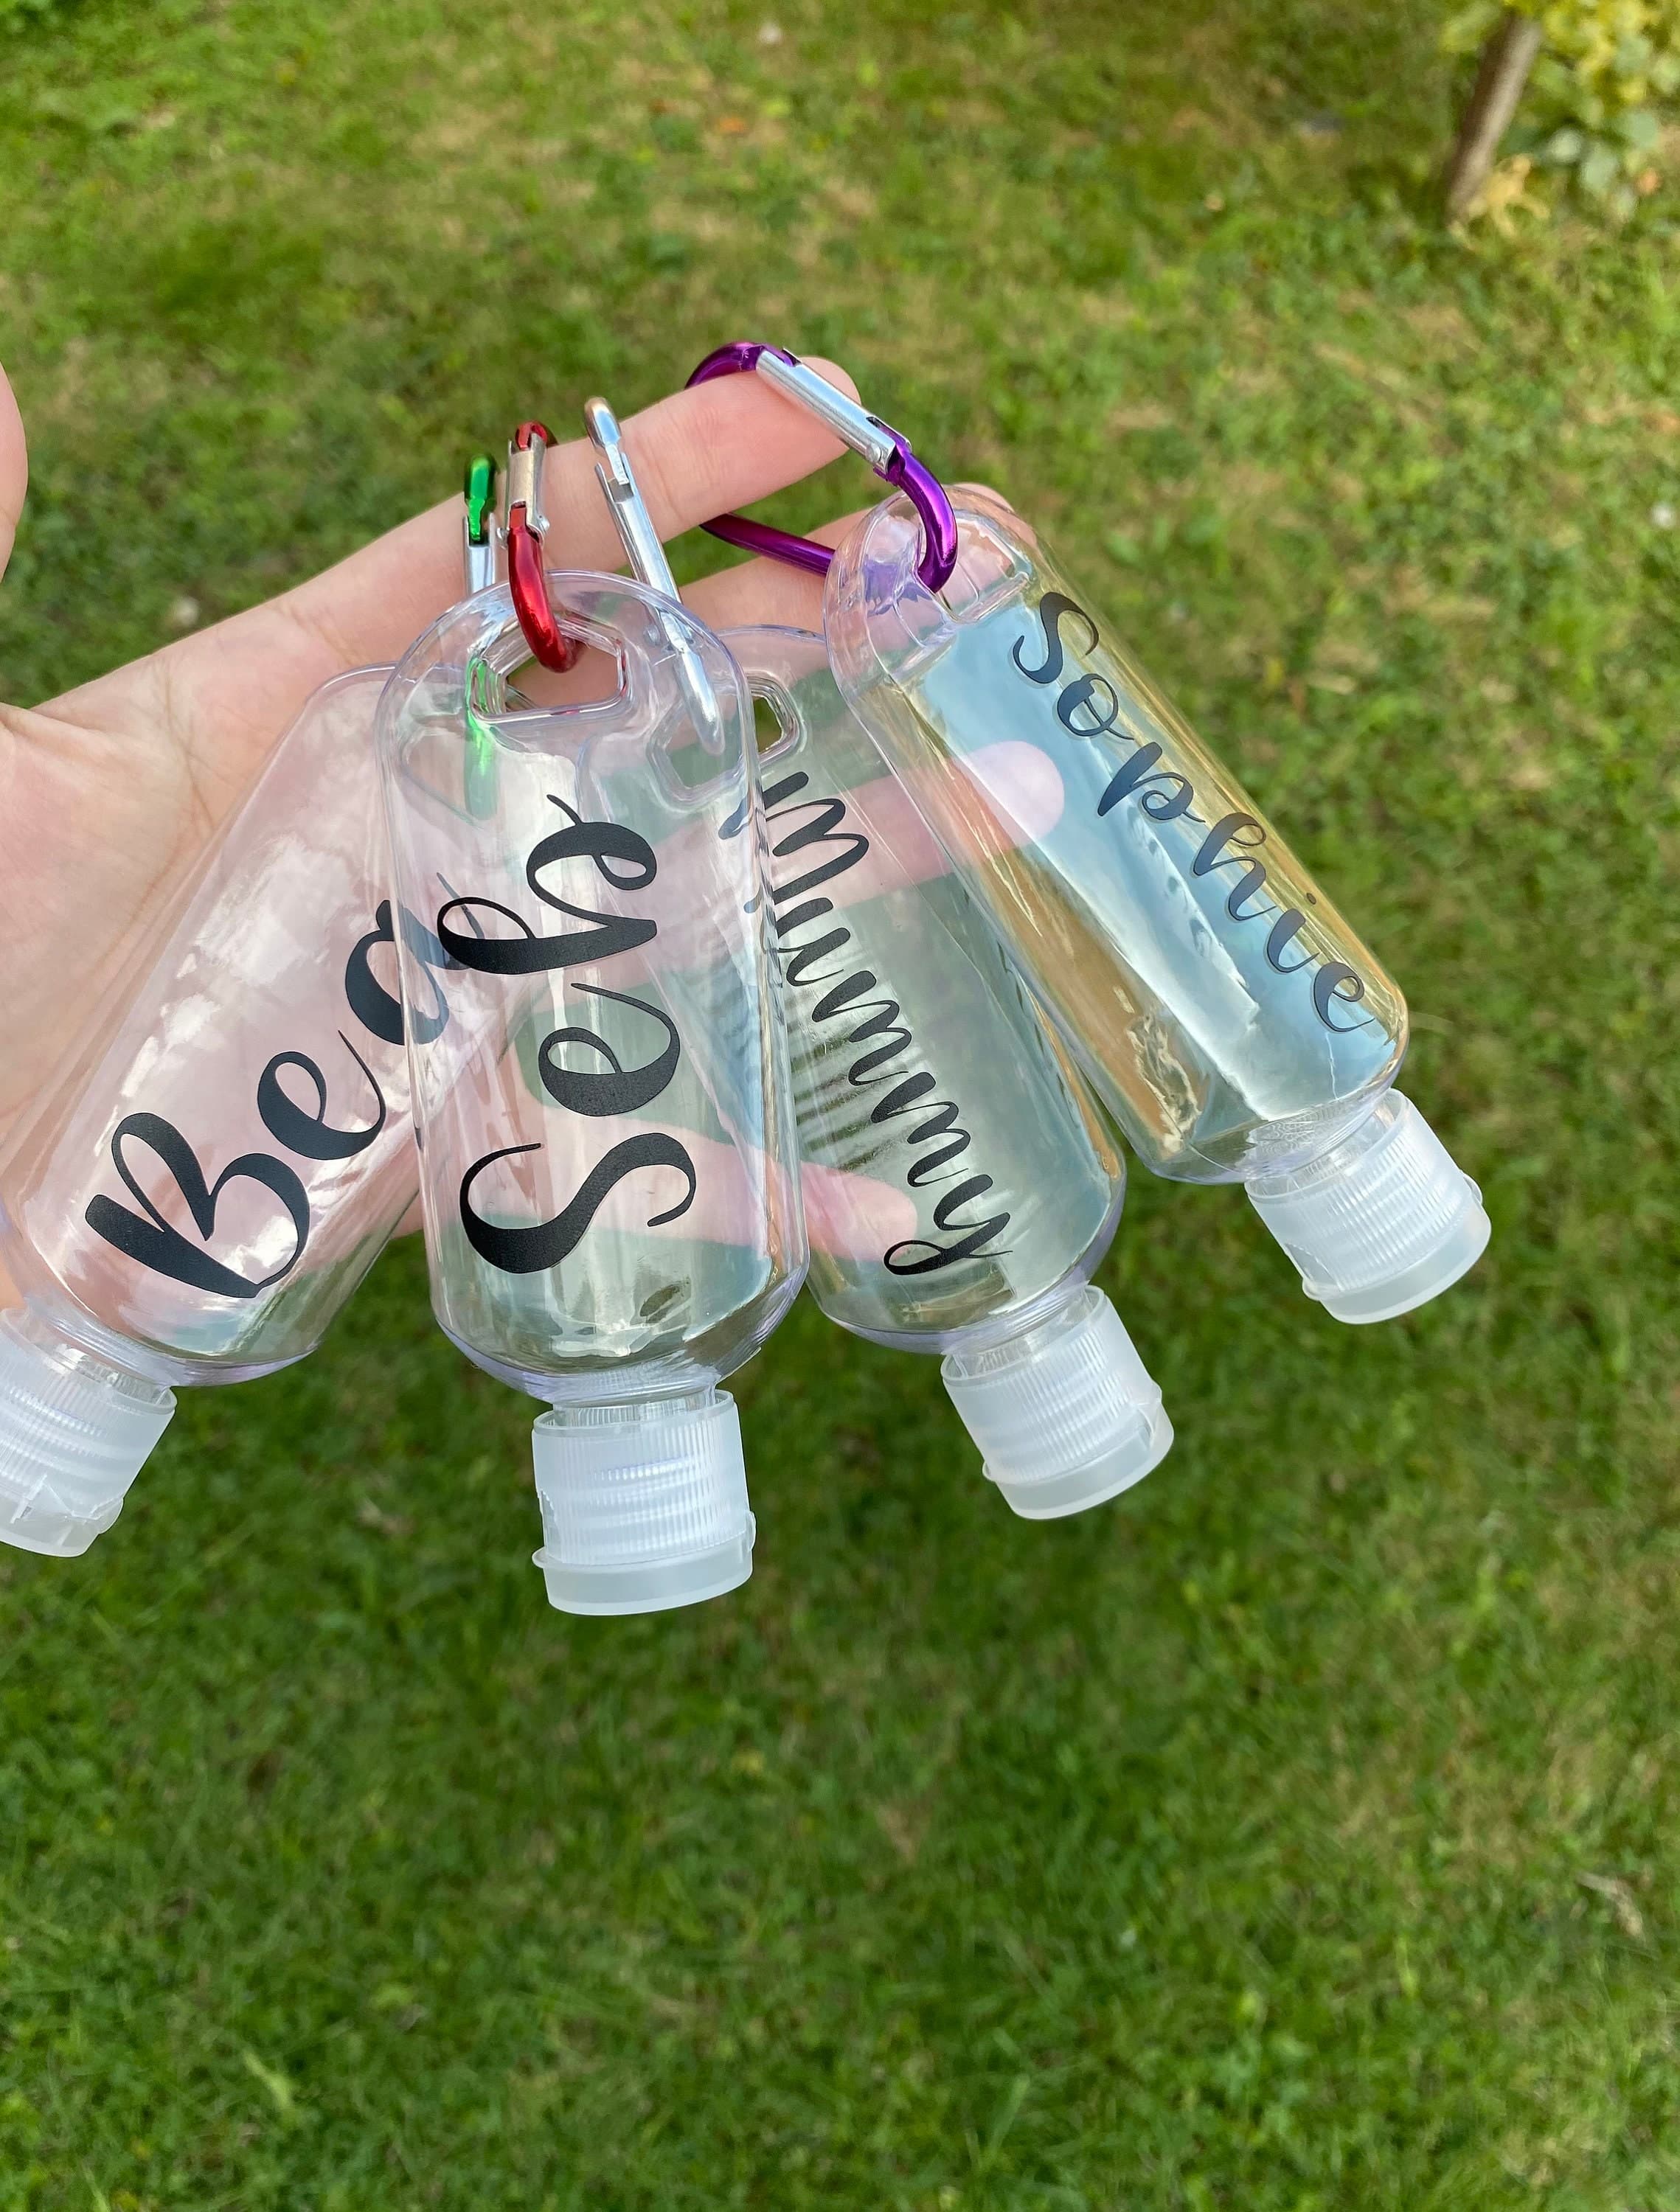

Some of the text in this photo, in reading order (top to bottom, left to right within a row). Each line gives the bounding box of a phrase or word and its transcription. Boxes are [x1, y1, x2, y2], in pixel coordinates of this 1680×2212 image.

[437, 794, 697, 1274] Seb
[718, 771, 1014, 1276] Mummy
[1013, 591, 1376, 1032] Sophie
[84, 871, 485, 1299] Bea
